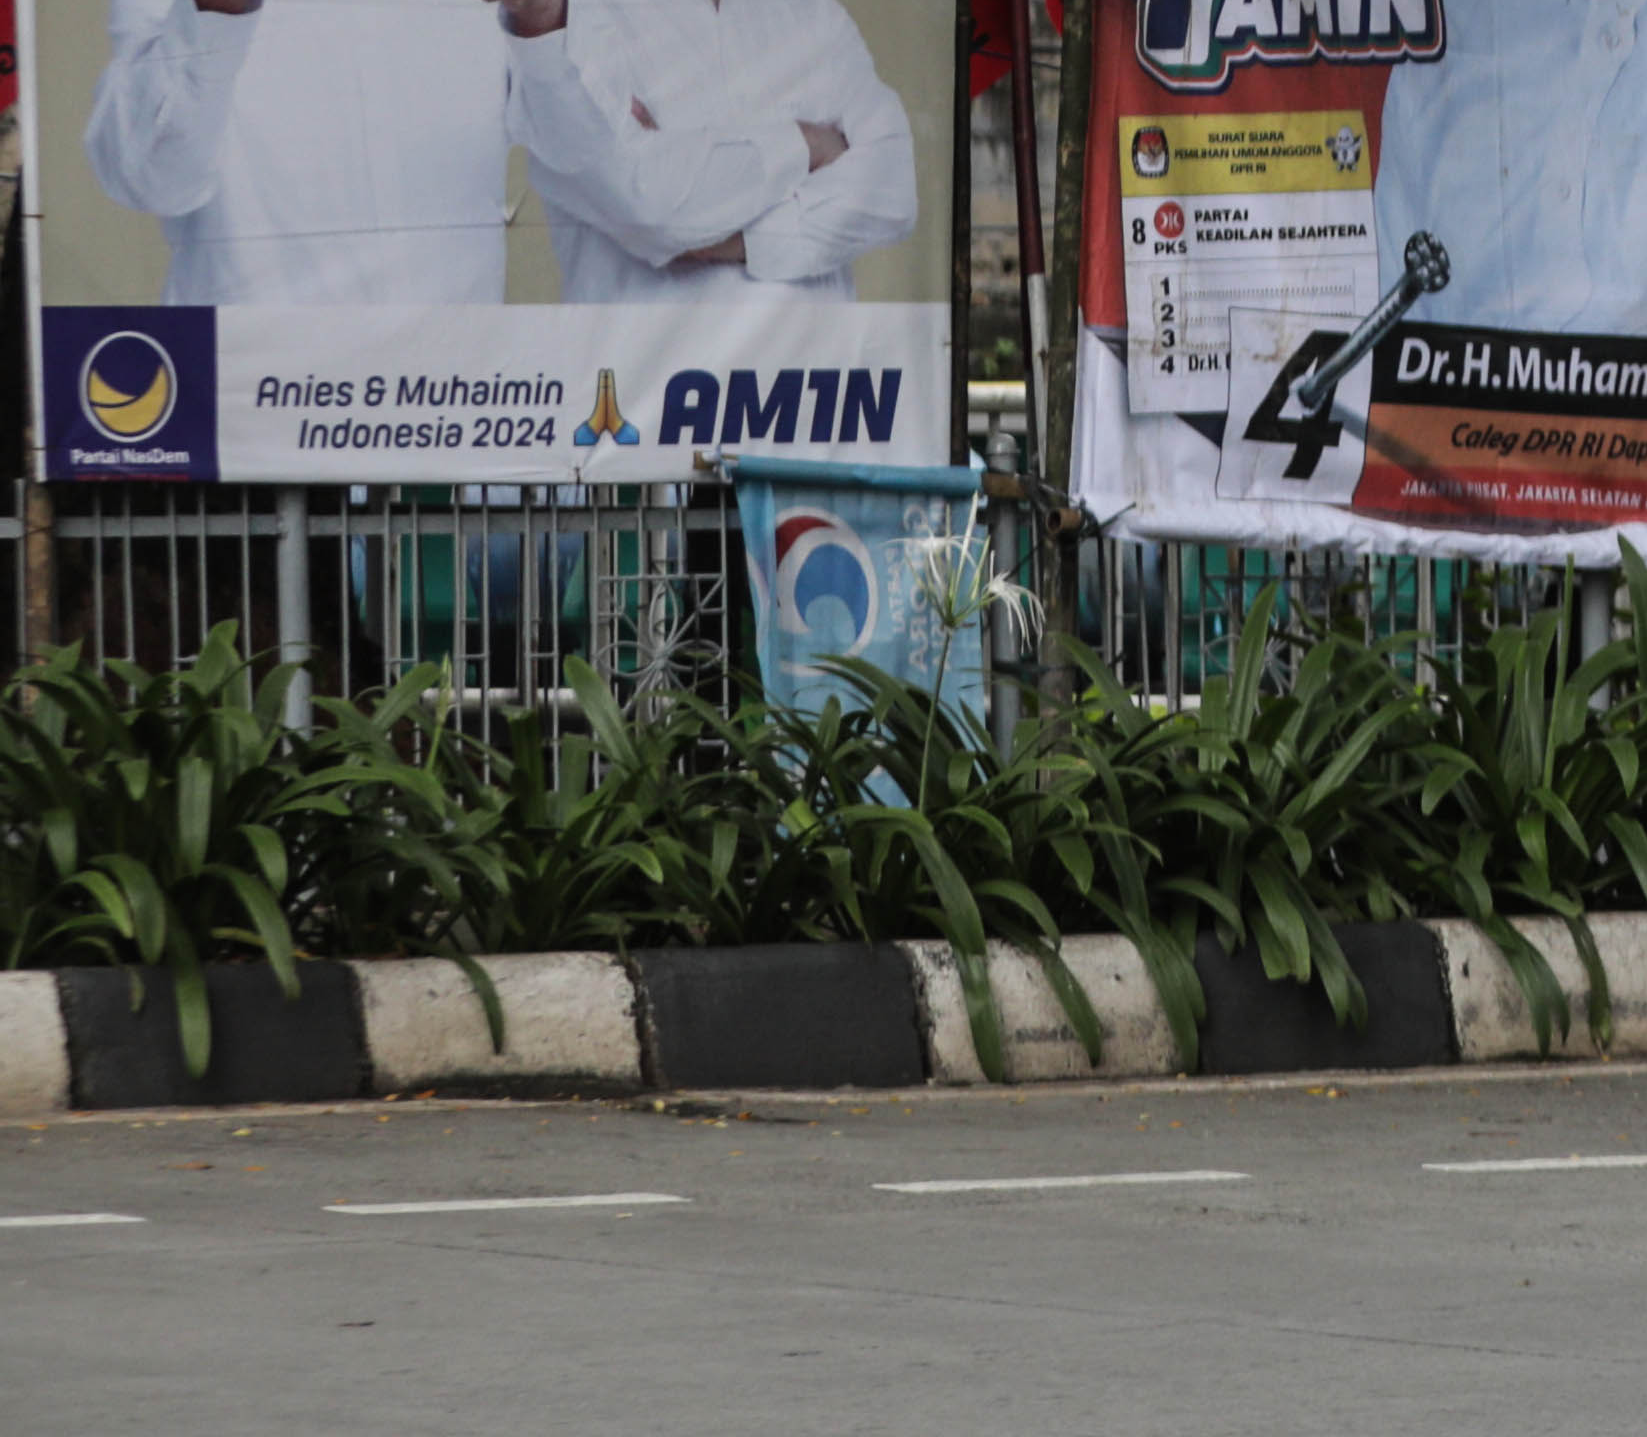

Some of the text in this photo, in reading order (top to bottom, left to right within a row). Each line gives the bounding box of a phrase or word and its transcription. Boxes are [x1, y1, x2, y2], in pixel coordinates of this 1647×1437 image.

[1194, 208, 1249, 224] PARTAI
[1131, 218, 1147, 246] 8
[1196, 223, 1368, 243] KEADILAN SEJAHTERA
[1154, 240, 1188, 256] PKS
[1159, 276, 1171, 296] 1
[1160, 303, 1175, 322] 2
[1161, 329, 1176, 348] 3
[1160, 355, 1175, 374] 4
[255, 372, 565, 409] Anies & Muhaimin
[1242, 329, 1352, 481] 4
[297, 415, 558, 450] Indonesia 2024
[1450, 422, 1521, 457] Caleg
[1521, 432, 1577, 458] DPR
[1578, 431, 1605, 459] RI
